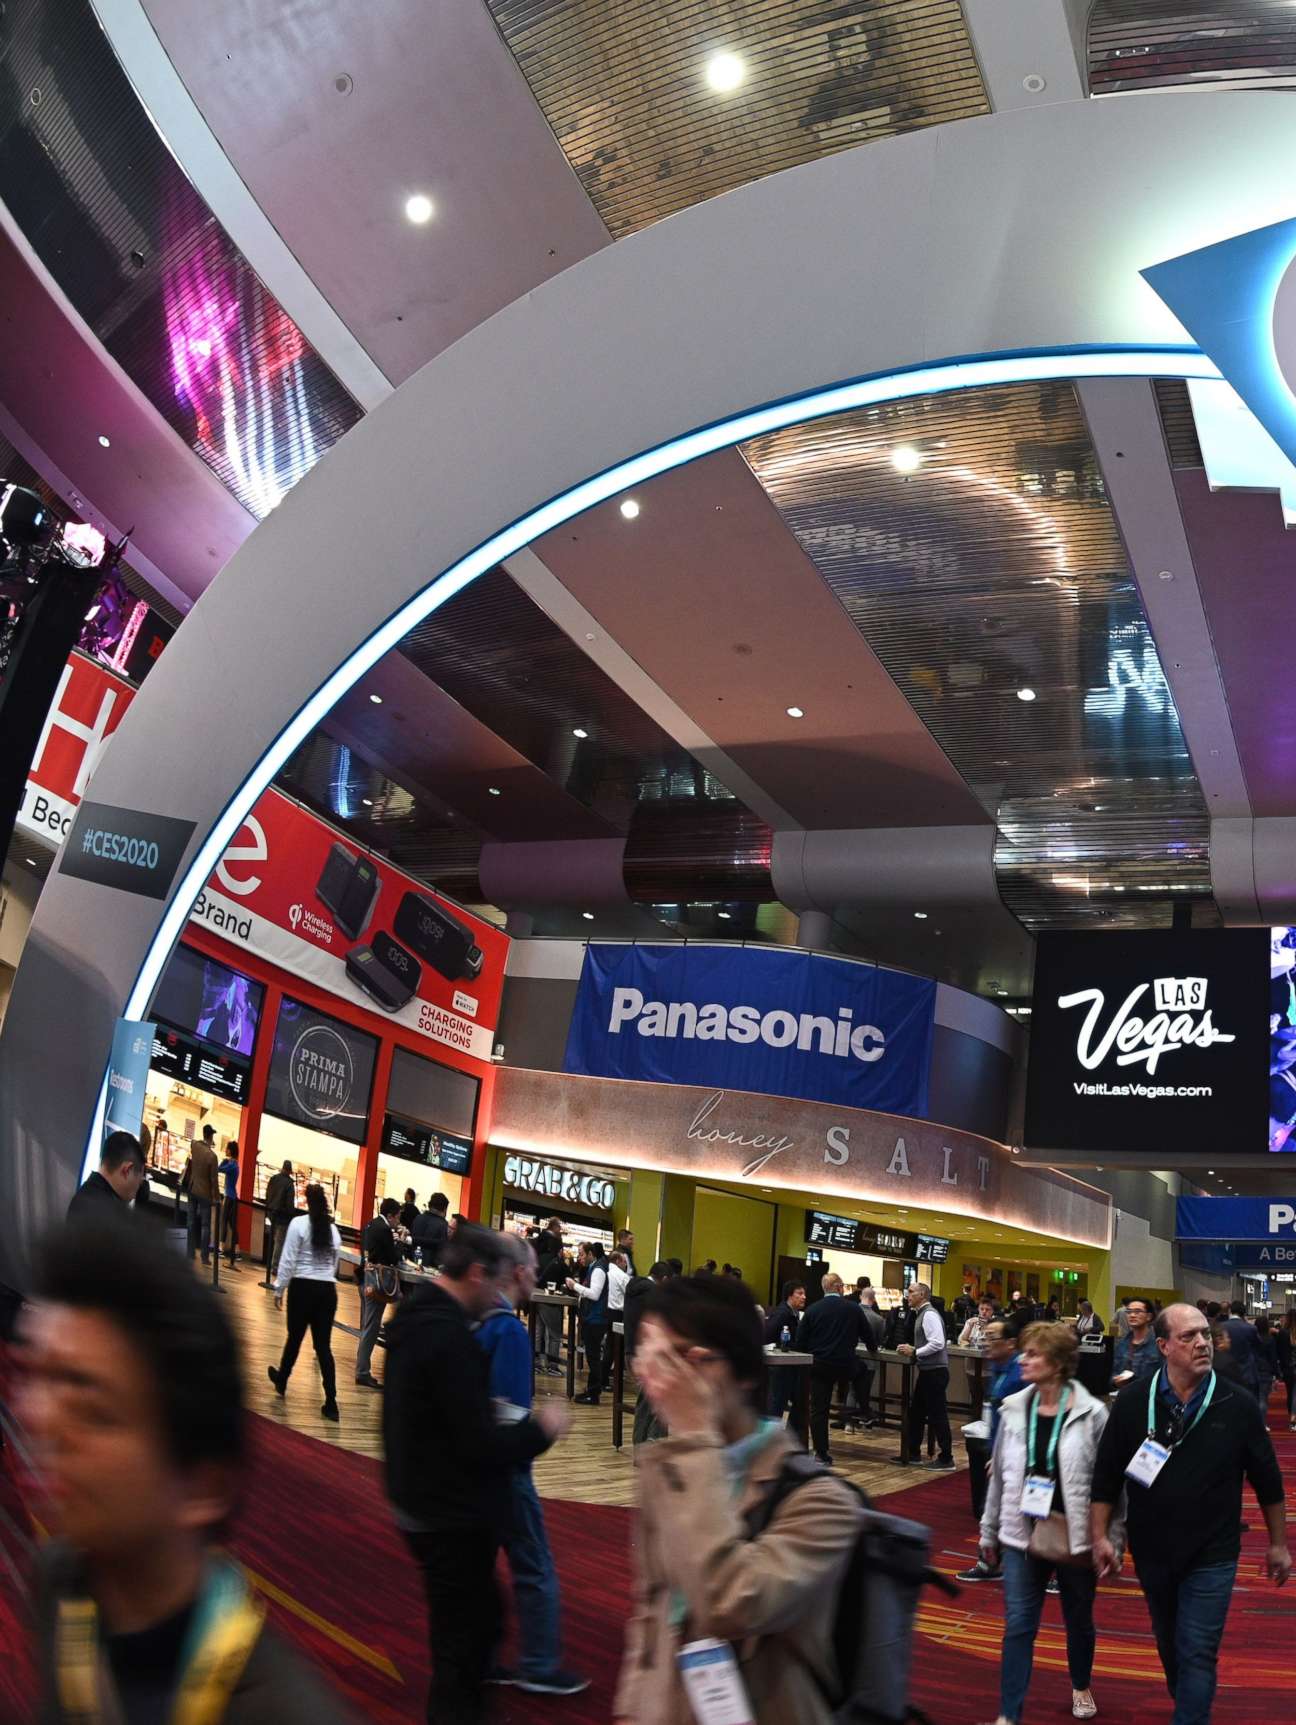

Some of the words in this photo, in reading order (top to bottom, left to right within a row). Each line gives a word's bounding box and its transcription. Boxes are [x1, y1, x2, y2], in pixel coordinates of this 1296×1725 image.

[82, 828, 160, 870] #CES2020
[193, 892, 253, 942] Brand
[301, 921, 333, 945] Charging
[304, 909, 334, 935] Wireless
[1160, 982, 1201, 1007] LAS
[417, 1017, 472, 1049] SOLUTIONS
[420, 1004, 474, 1037] CHARGING
[607, 987, 887, 1063] Panasonic
[1057, 982, 1236, 1076] Vegas
[300, 1047, 346, 1078] PRIMA
[296, 1063, 344, 1100] STAMPA
[1073, 1082, 1212, 1099] VisitLasVegas.com
[686, 1090, 795, 1177] honey
[822, 1125, 990, 1191] SALT
[1259, 1247, 1271, 1261] A
